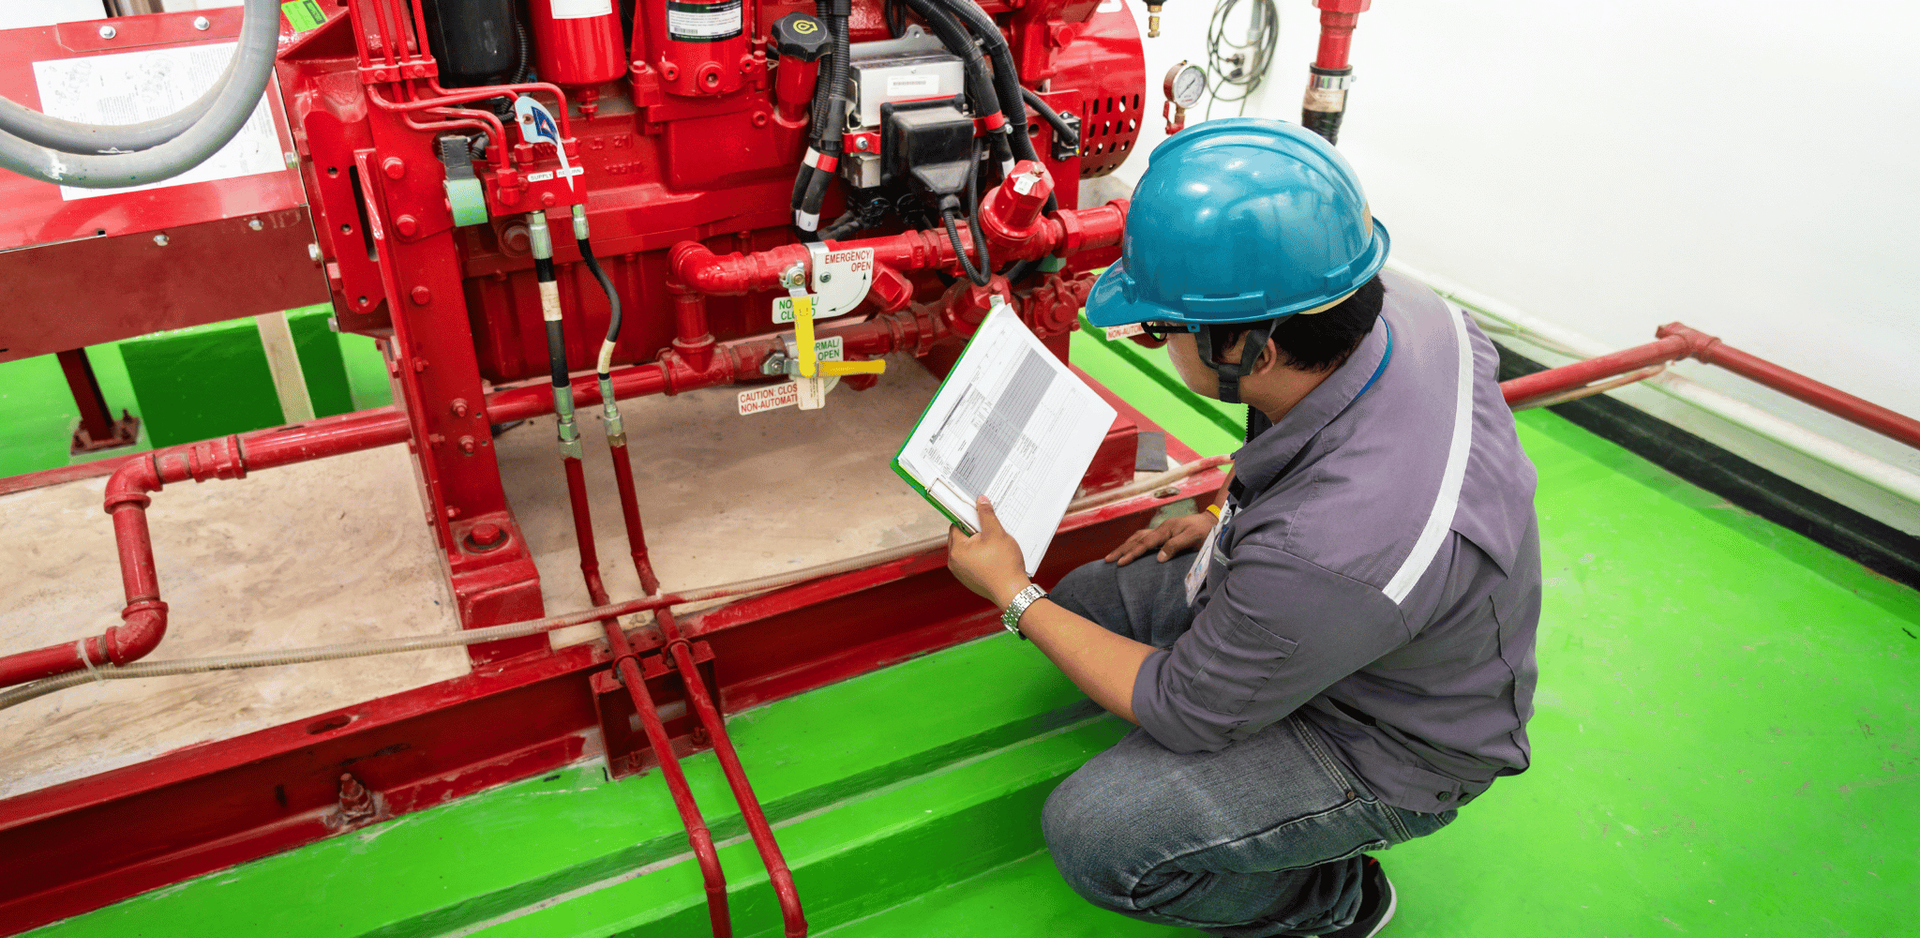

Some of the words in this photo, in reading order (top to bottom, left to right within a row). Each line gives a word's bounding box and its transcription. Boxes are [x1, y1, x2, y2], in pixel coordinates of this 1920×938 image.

[530, 172, 553, 180] SUPPLY
[825, 250, 872, 265] EMERGENCY/
[851, 261, 871, 273] OPEN
[779, 296, 819, 310] NOL/
[780, 307, 816, 321] CLD
[1108, 323, 1143, 339] NON-AUTOM
[815, 338, 840, 351] RMAL/
[817, 349, 840, 361] OPEN
[740, 388, 776, 403] CAUTION:
[777, 383, 798, 397] CLOS
[741, 394, 798, 413] NON-AUTOMATI
